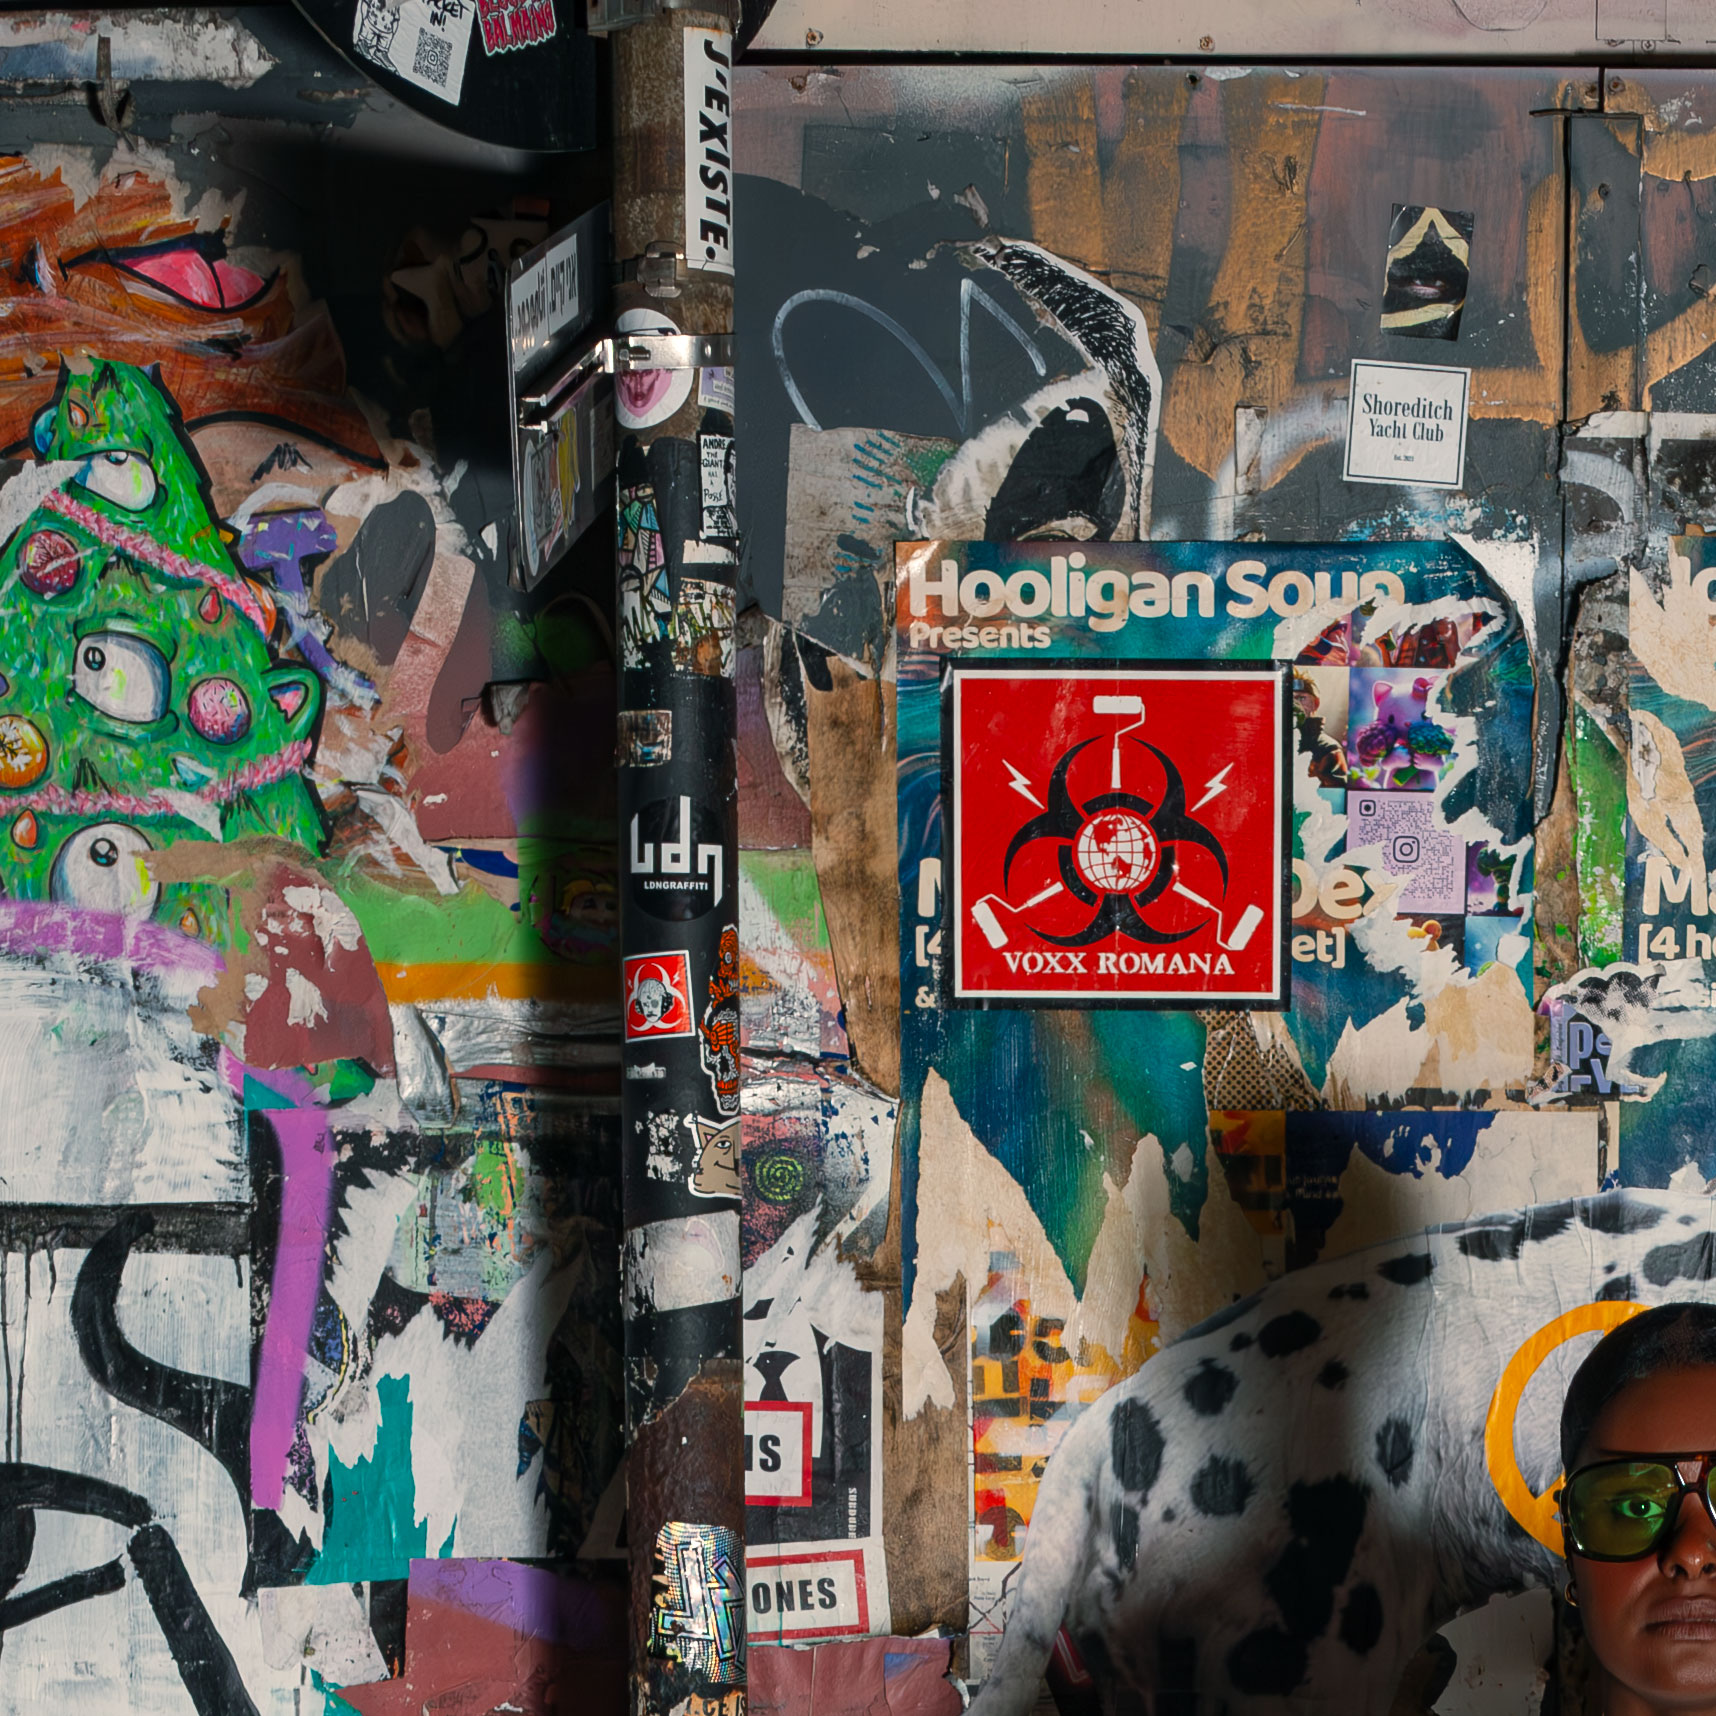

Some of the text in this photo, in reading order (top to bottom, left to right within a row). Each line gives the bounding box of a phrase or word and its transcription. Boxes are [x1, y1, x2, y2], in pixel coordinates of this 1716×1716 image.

[698, 37, 732, 263] J'EXISTE.
[1362, 392, 1454, 421] Shoreditch
[1368, 418, 1444, 443] Yacht Club
[909, 552, 1215, 633] Hooligan
[909, 621, 1051, 650] Presents
[644, 881, 709, 891] LDNGRAFFITI
[1003, 950, 1236, 976] VOXX ROMANA
